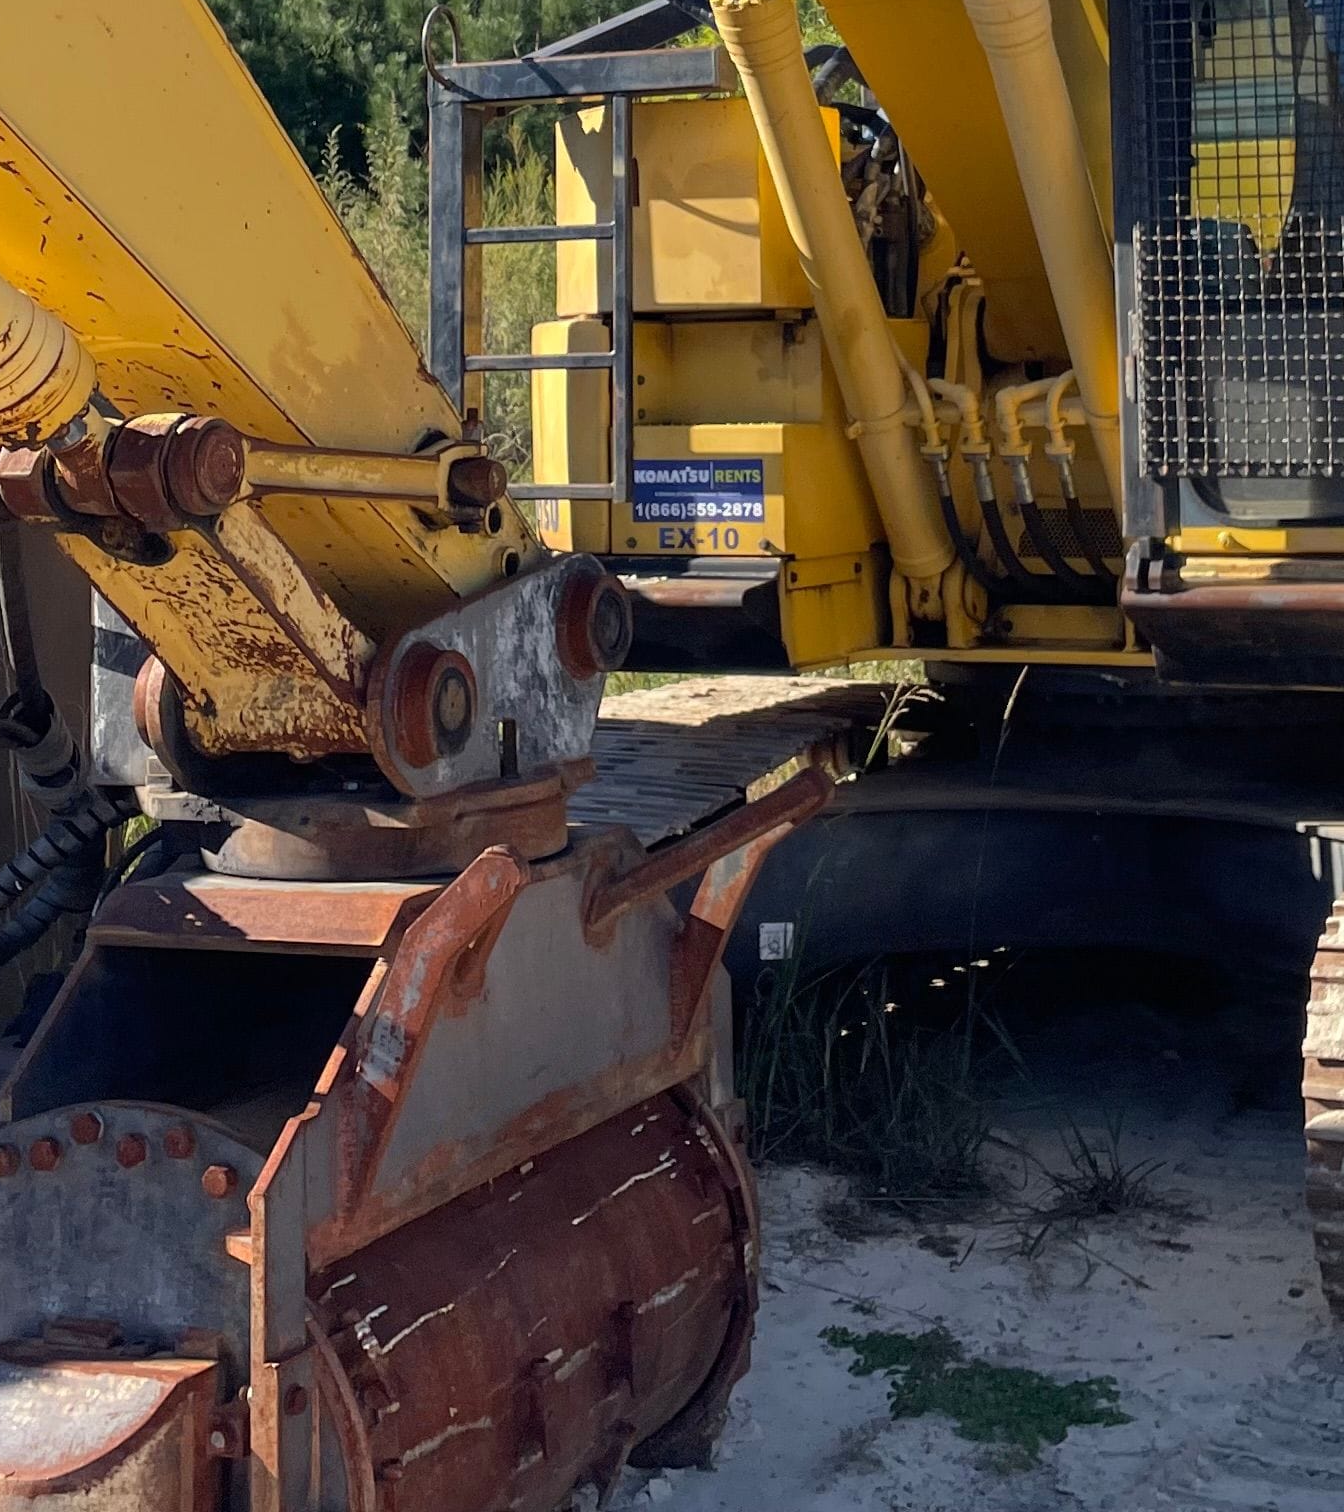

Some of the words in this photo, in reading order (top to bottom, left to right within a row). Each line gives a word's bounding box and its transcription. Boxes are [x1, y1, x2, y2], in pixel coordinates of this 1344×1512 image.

[634, 467, 709, 483] KOMATSU
[715, 470, 761, 483] RENTS
[636, 502, 763, 519] 1(866)559-2878
[659, 528, 739, 549] EX-10
